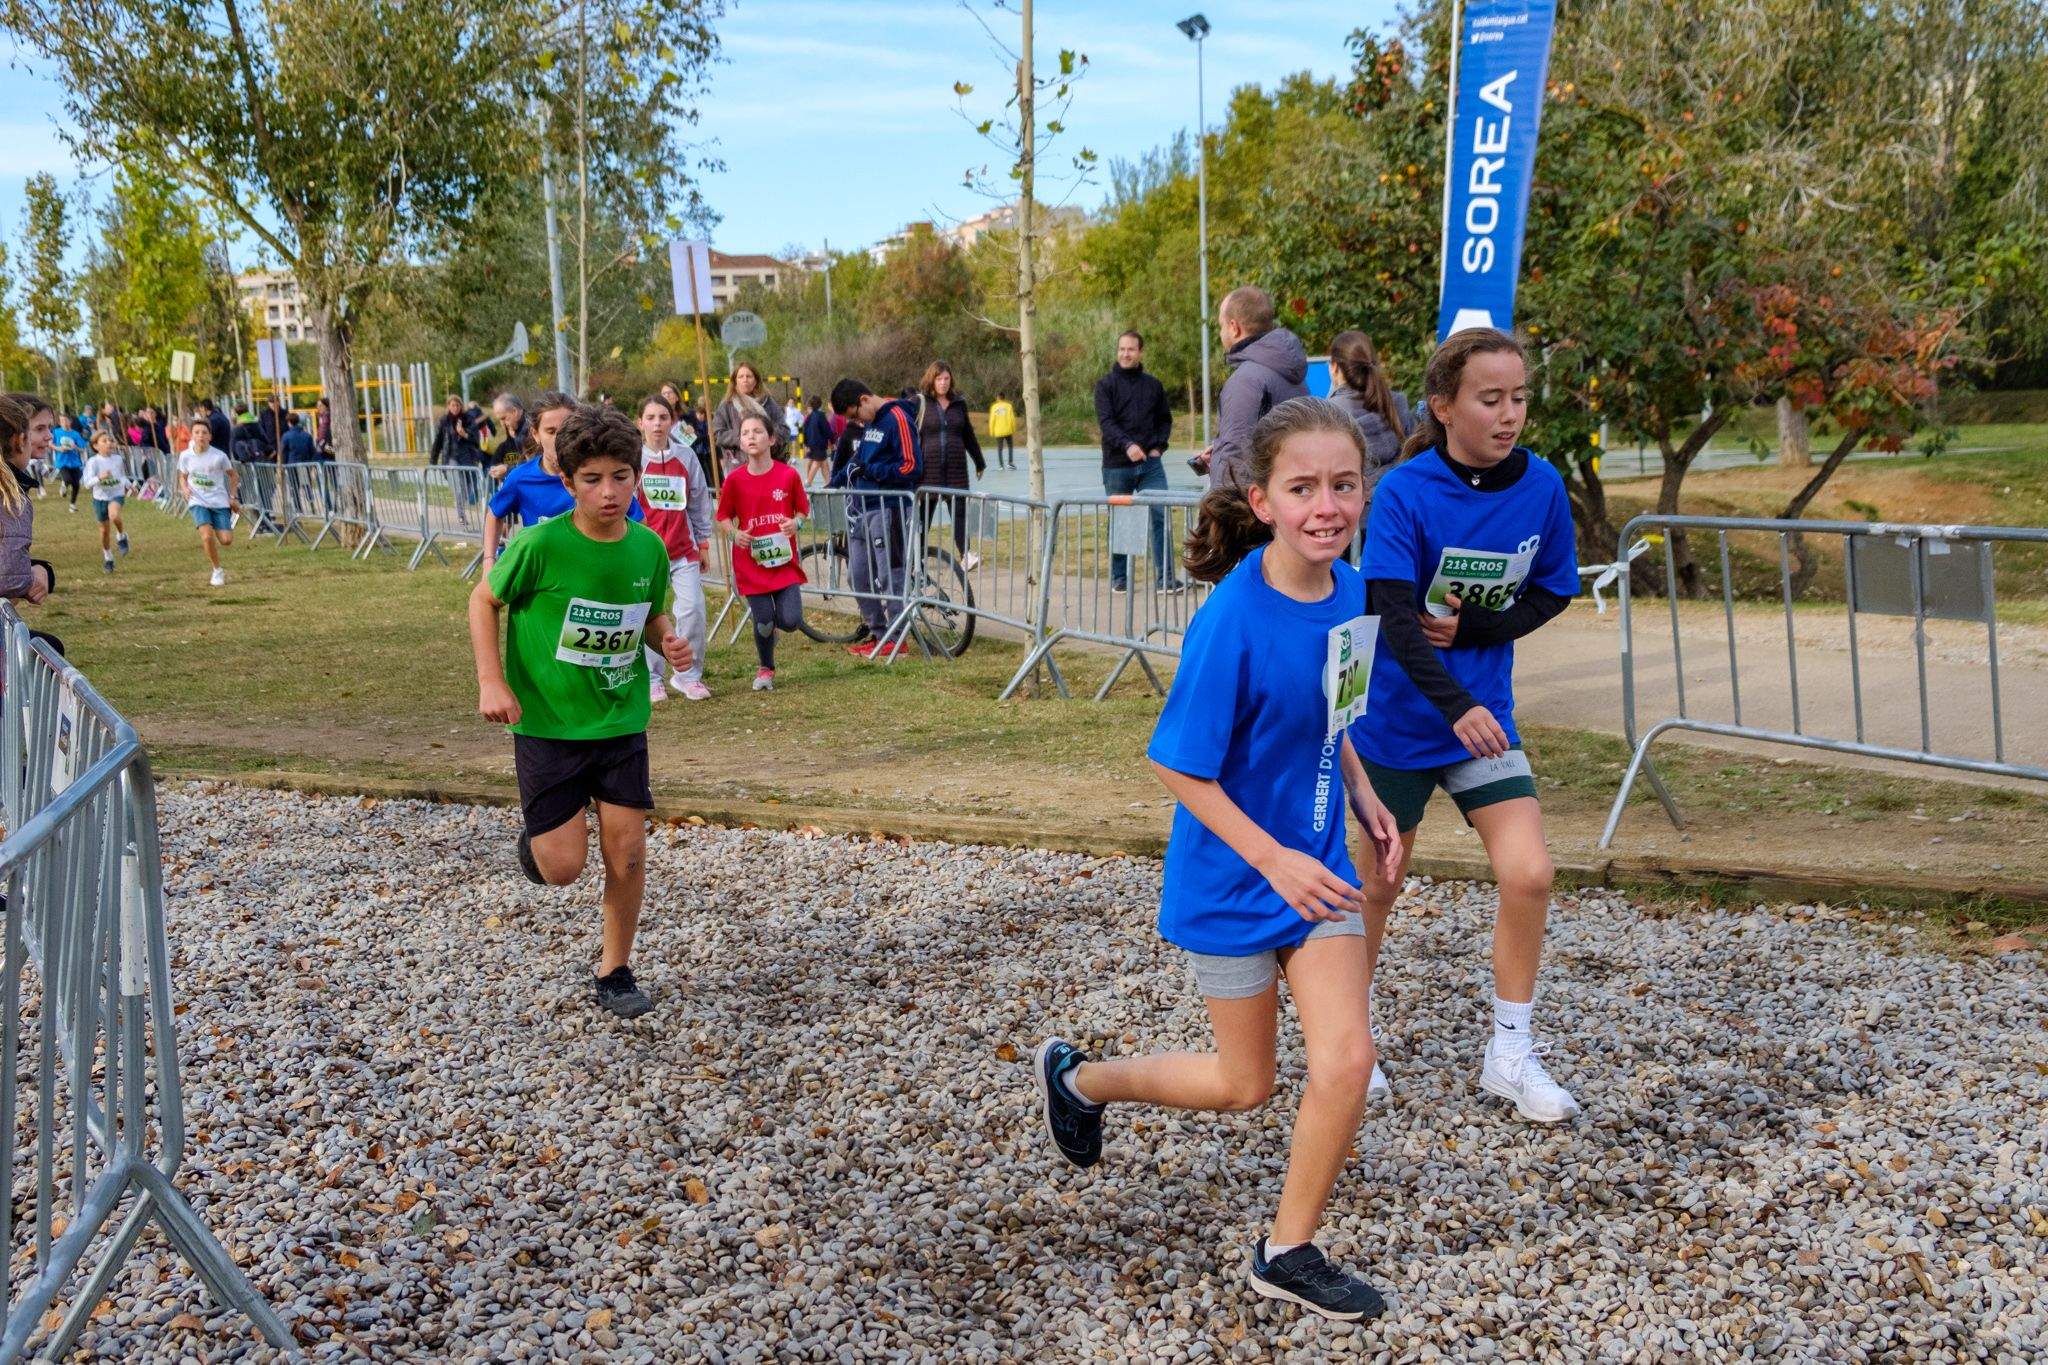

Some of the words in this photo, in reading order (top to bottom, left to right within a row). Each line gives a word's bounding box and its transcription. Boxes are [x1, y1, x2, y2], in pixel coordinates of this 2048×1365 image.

[1462, 69, 1518, 274] SOREA
[652, 489, 676, 501] 202
[759, 546, 783, 560] 812
[1445, 560, 1468, 570] 21è
[1470, 561, 1503, 571] CROS
[572, 608, 592, 618] 21è
[593, 611, 621, 620] CROS
[573, 627, 635, 651] 2367
[1313, 773, 1331, 832] GERBERT
